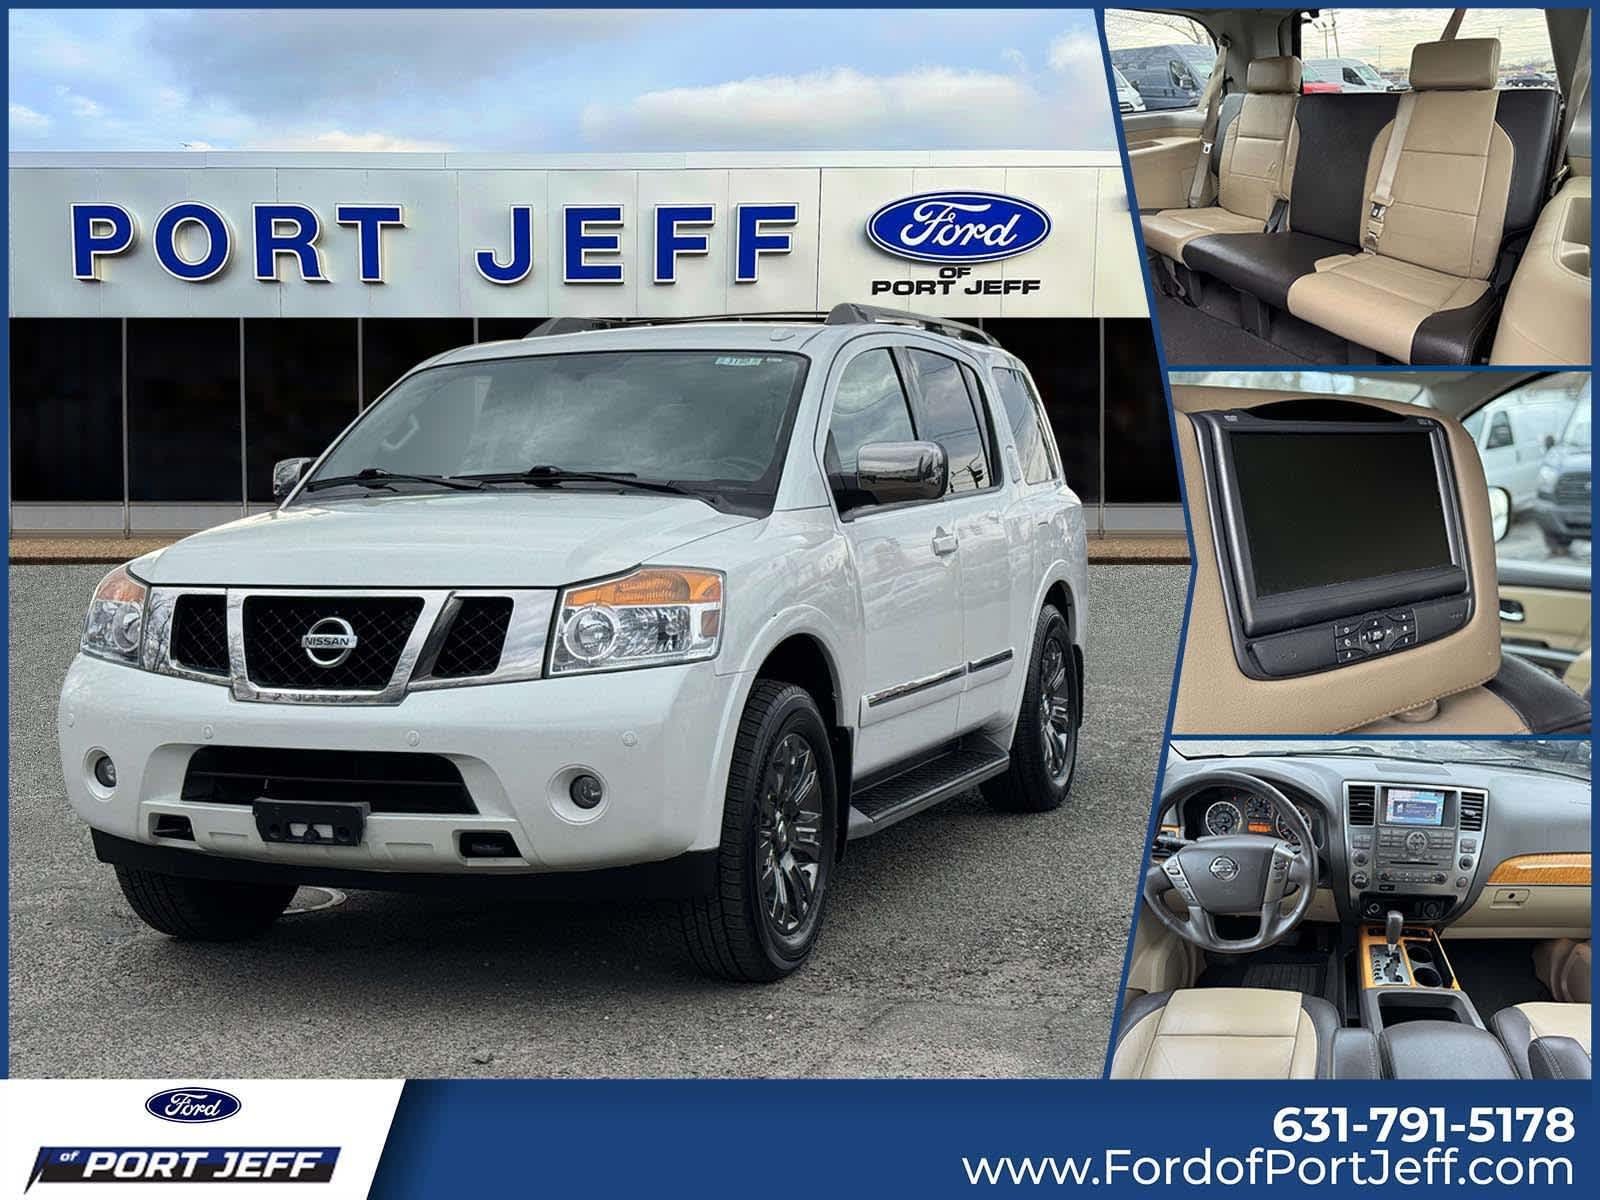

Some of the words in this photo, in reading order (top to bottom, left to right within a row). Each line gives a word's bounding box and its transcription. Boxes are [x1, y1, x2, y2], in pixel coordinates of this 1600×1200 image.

[900, 201, 1021, 246] Ford
[71, 202, 403, 282] PORT
[475, 203, 798, 284] JEFF
[939, 267, 972, 279] OF
[871, 280, 956, 295] PORT
[964, 280, 1041, 295] JEFF
[304, 637, 350, 646] NISSAN
